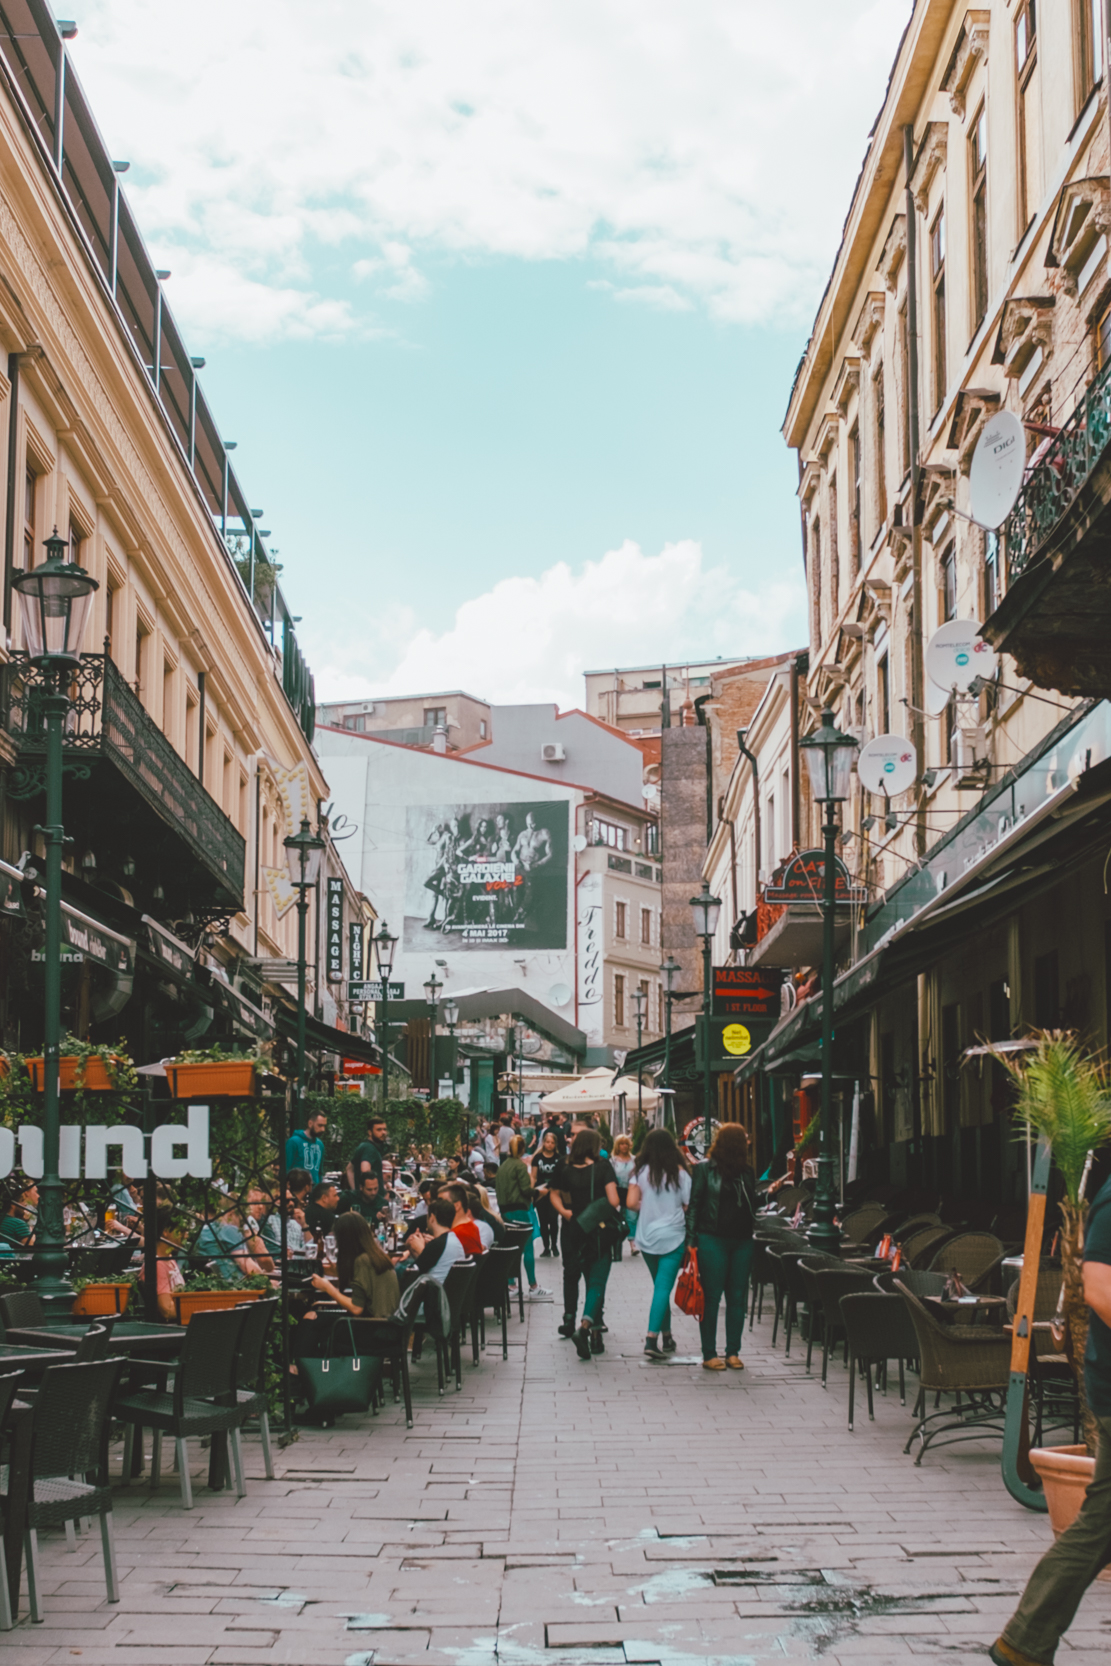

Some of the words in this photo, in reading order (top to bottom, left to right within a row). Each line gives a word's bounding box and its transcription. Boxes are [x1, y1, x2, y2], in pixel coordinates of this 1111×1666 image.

[457, 863, 515, 873] GARDIENII
[460, 872, 515, 883] GALAXIEI
[788, 879, 807, 887] on
[810, 877, 846, 889] FIE
[330, 880, 342, 969] MASSAGE
[487, 929, 508, 937] 2017
[352, 925, 361, 967] NIGHT
[743, 1003, 767, 1012] FLOOR
[0, 1105, 212, 1178] und
